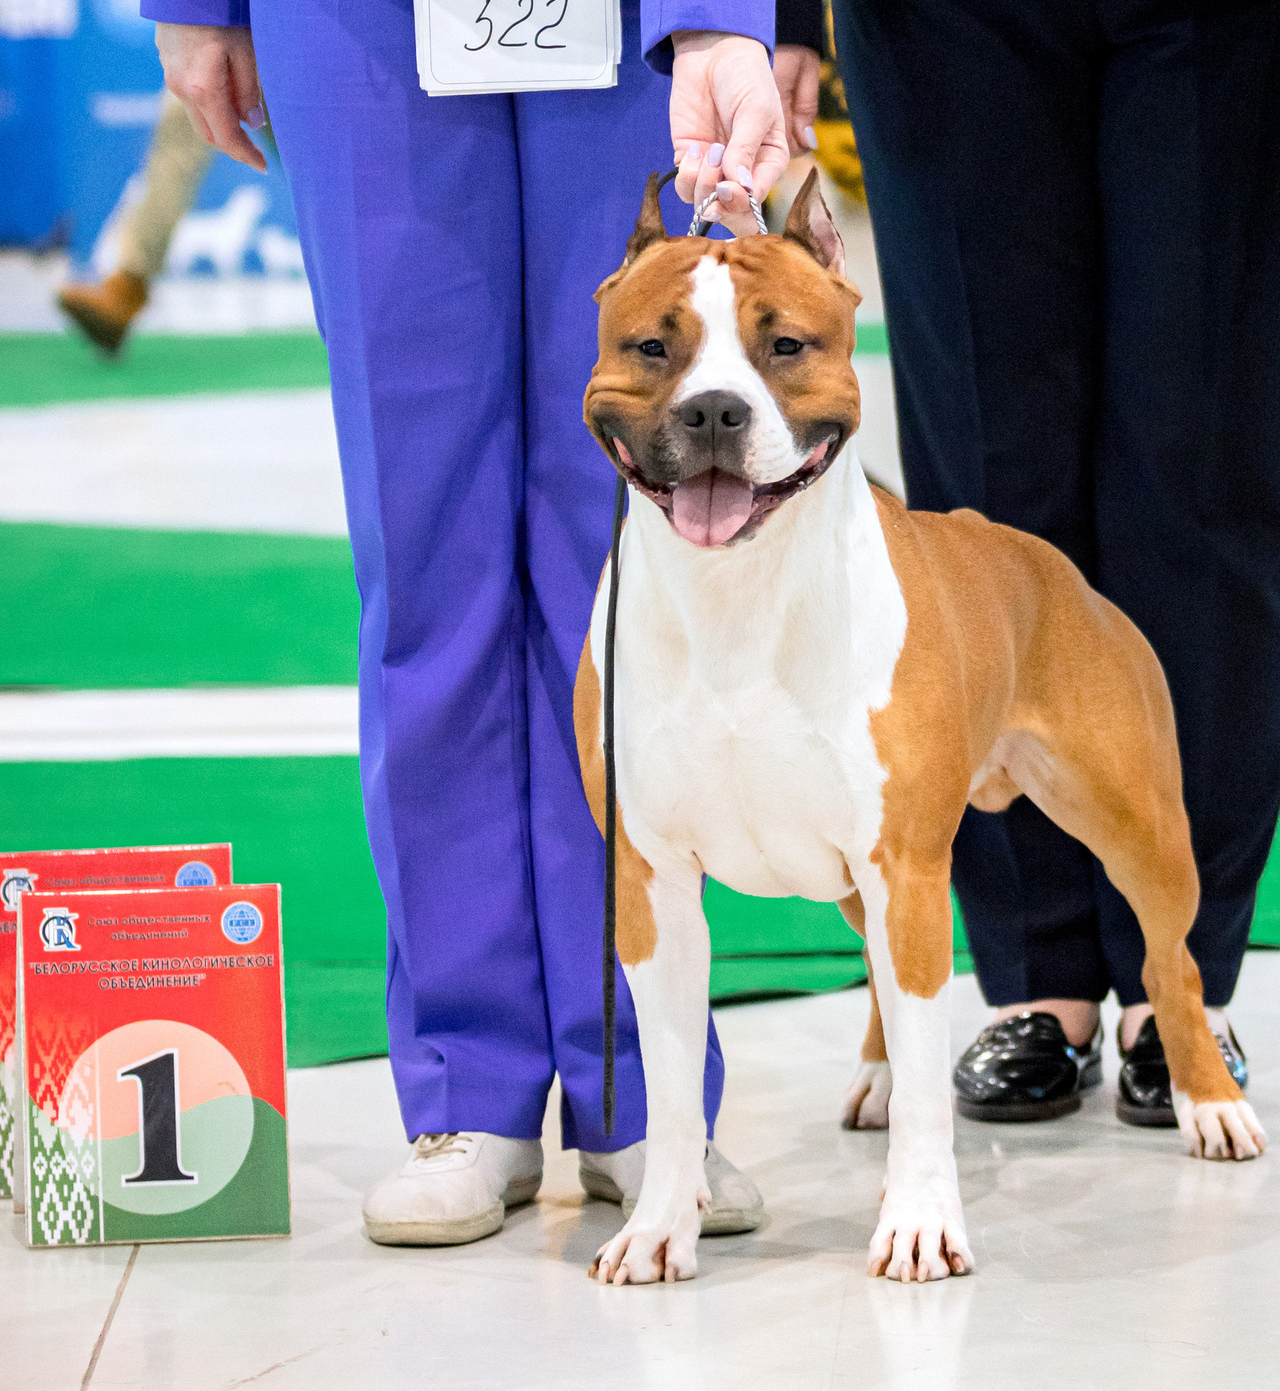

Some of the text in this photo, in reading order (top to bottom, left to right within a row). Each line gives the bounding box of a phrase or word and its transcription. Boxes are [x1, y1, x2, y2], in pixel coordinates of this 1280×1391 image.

[87, 914, 211, 927] Союз общественных
[110, 928, 189, 941] объединений
[29, 955, 274, 975] "БЕЛОРУССКОЕ КИНОЛОГИЧЕСКОЕ
[98, 973, 206, 990] ОБЪЕДИНЕНИЕ"
[118, 1049, 196, 1185] 1
